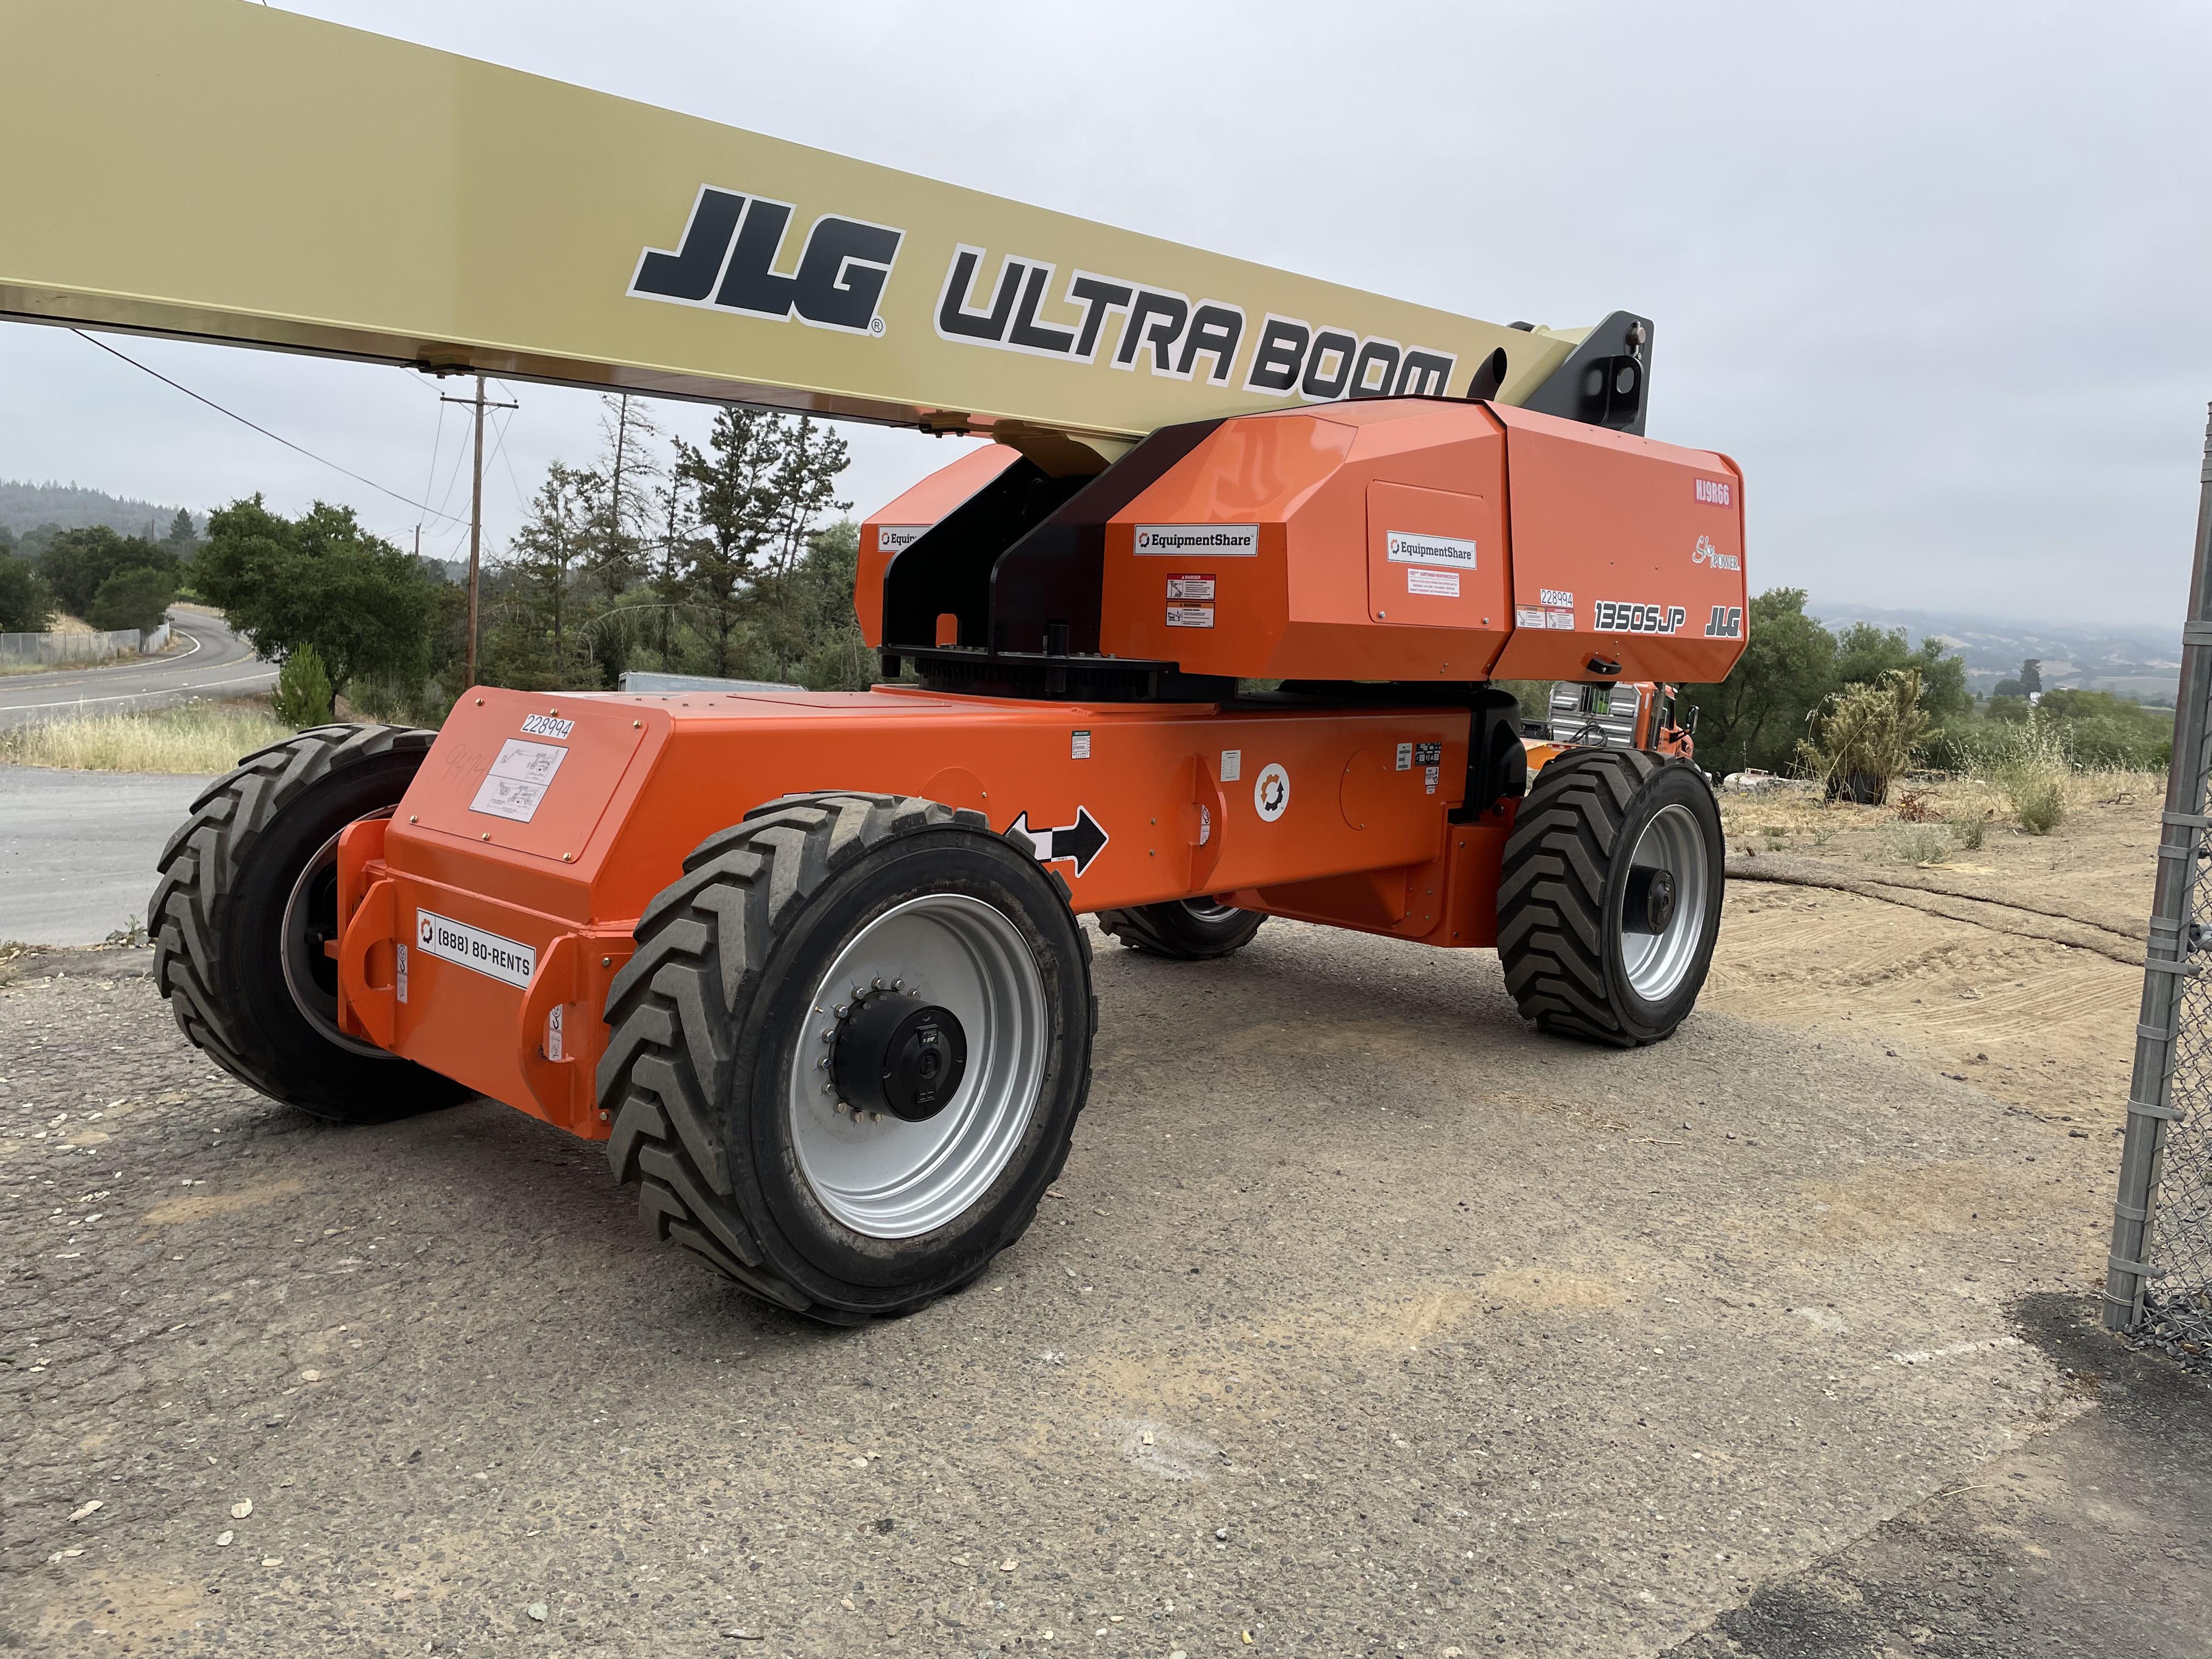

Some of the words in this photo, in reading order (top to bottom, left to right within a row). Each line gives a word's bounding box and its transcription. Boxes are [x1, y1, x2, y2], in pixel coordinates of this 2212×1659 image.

[629, 185, 905, 334] JLG
[936, 246, 1244, 384] ULTRA
[1245, 315, 1457, 400] BOOM
[1152, 534, 1251, 548] EquipmentShare
[1401, 541, 1471, 560] EquipmentShare
[1692, 535, 1715, 567] Sky
[1712, 554, 1739, 570] POWER
[1542, 590, 1572, 607] 228994
[1595, 601, 1685, 634] 1350SJP
[1705, 606, 1741, 637] JLG
[522, 715, 572, 738] 228994
[439, 928, 468, 955] (888)
[472, 941, 529, 976] 80-RENTS
